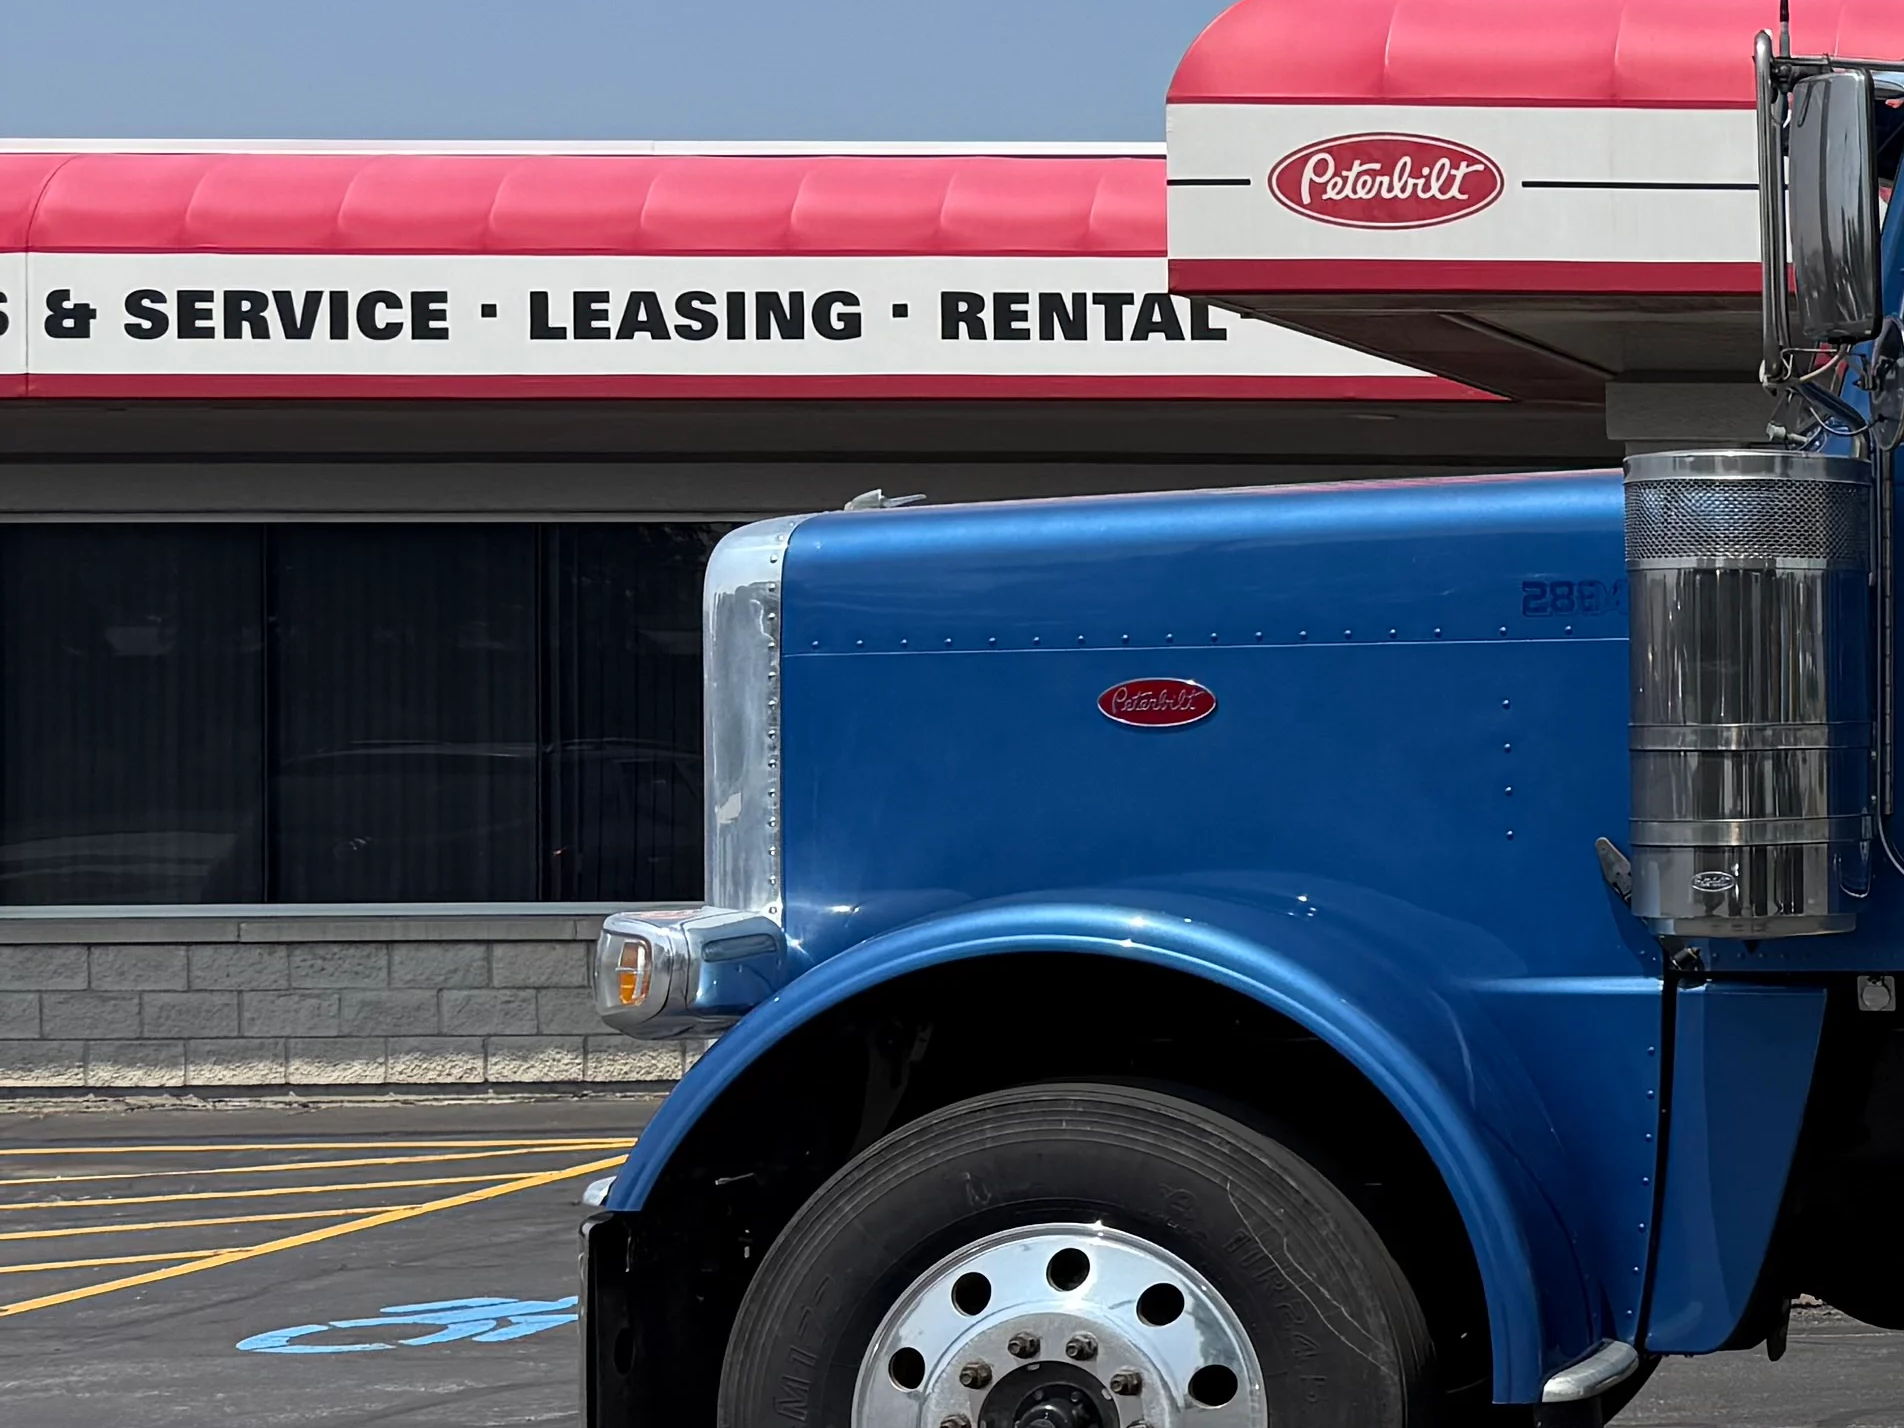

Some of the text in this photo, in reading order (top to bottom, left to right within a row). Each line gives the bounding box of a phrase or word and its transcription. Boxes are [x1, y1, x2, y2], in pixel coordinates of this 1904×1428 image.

[1300, 152, 1485, 205] Peterbilt
[44, 288, 97, 339] &
[123, 288, 449, 341] SERVICE
[529, 289, 864, 342] LEASING
[940, 290, 1228, 343] RENTAL
[1111, 687, 1205, 714] Peterbilt
